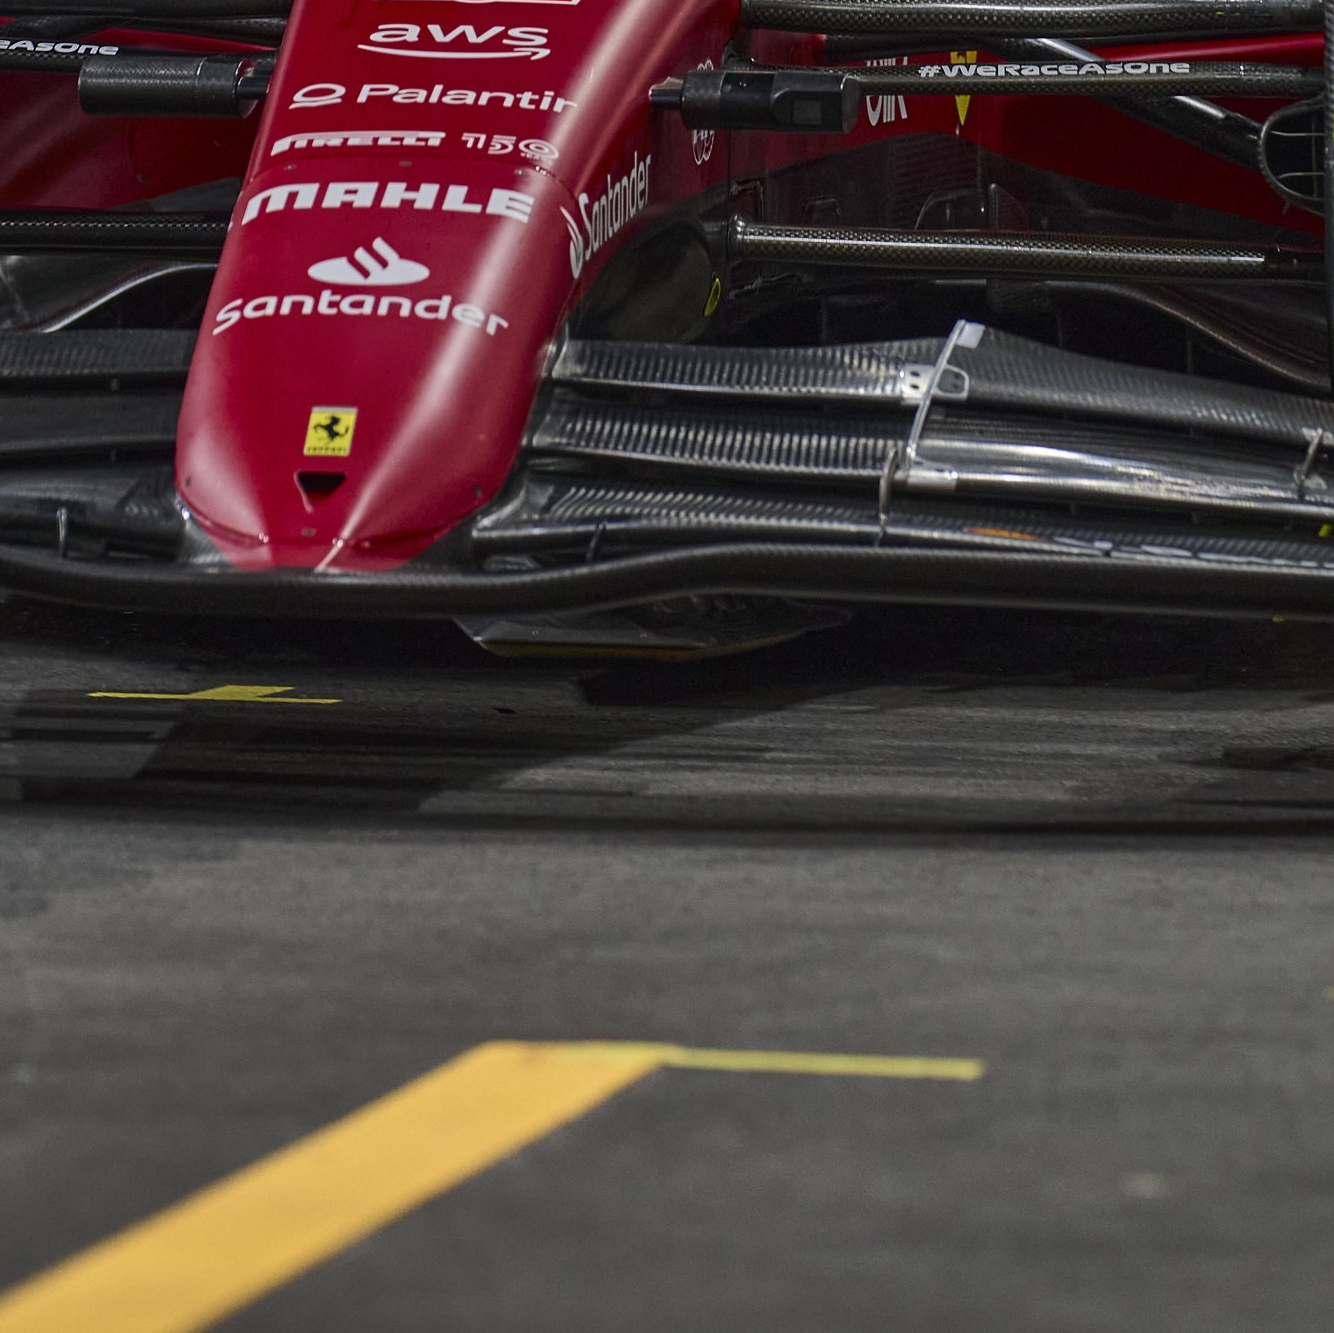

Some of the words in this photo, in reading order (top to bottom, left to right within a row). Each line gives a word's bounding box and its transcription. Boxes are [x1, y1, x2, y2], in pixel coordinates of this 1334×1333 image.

[369, 23, 549, 48] aws
[356, 83, 578, 114] Palantir
[270, 130, 446, 157] PIRELLI
[241, 181, 536, 225] MAHLE
[578, 150, 651, 261] Santander
[212, 289, 509, 336] Santander
